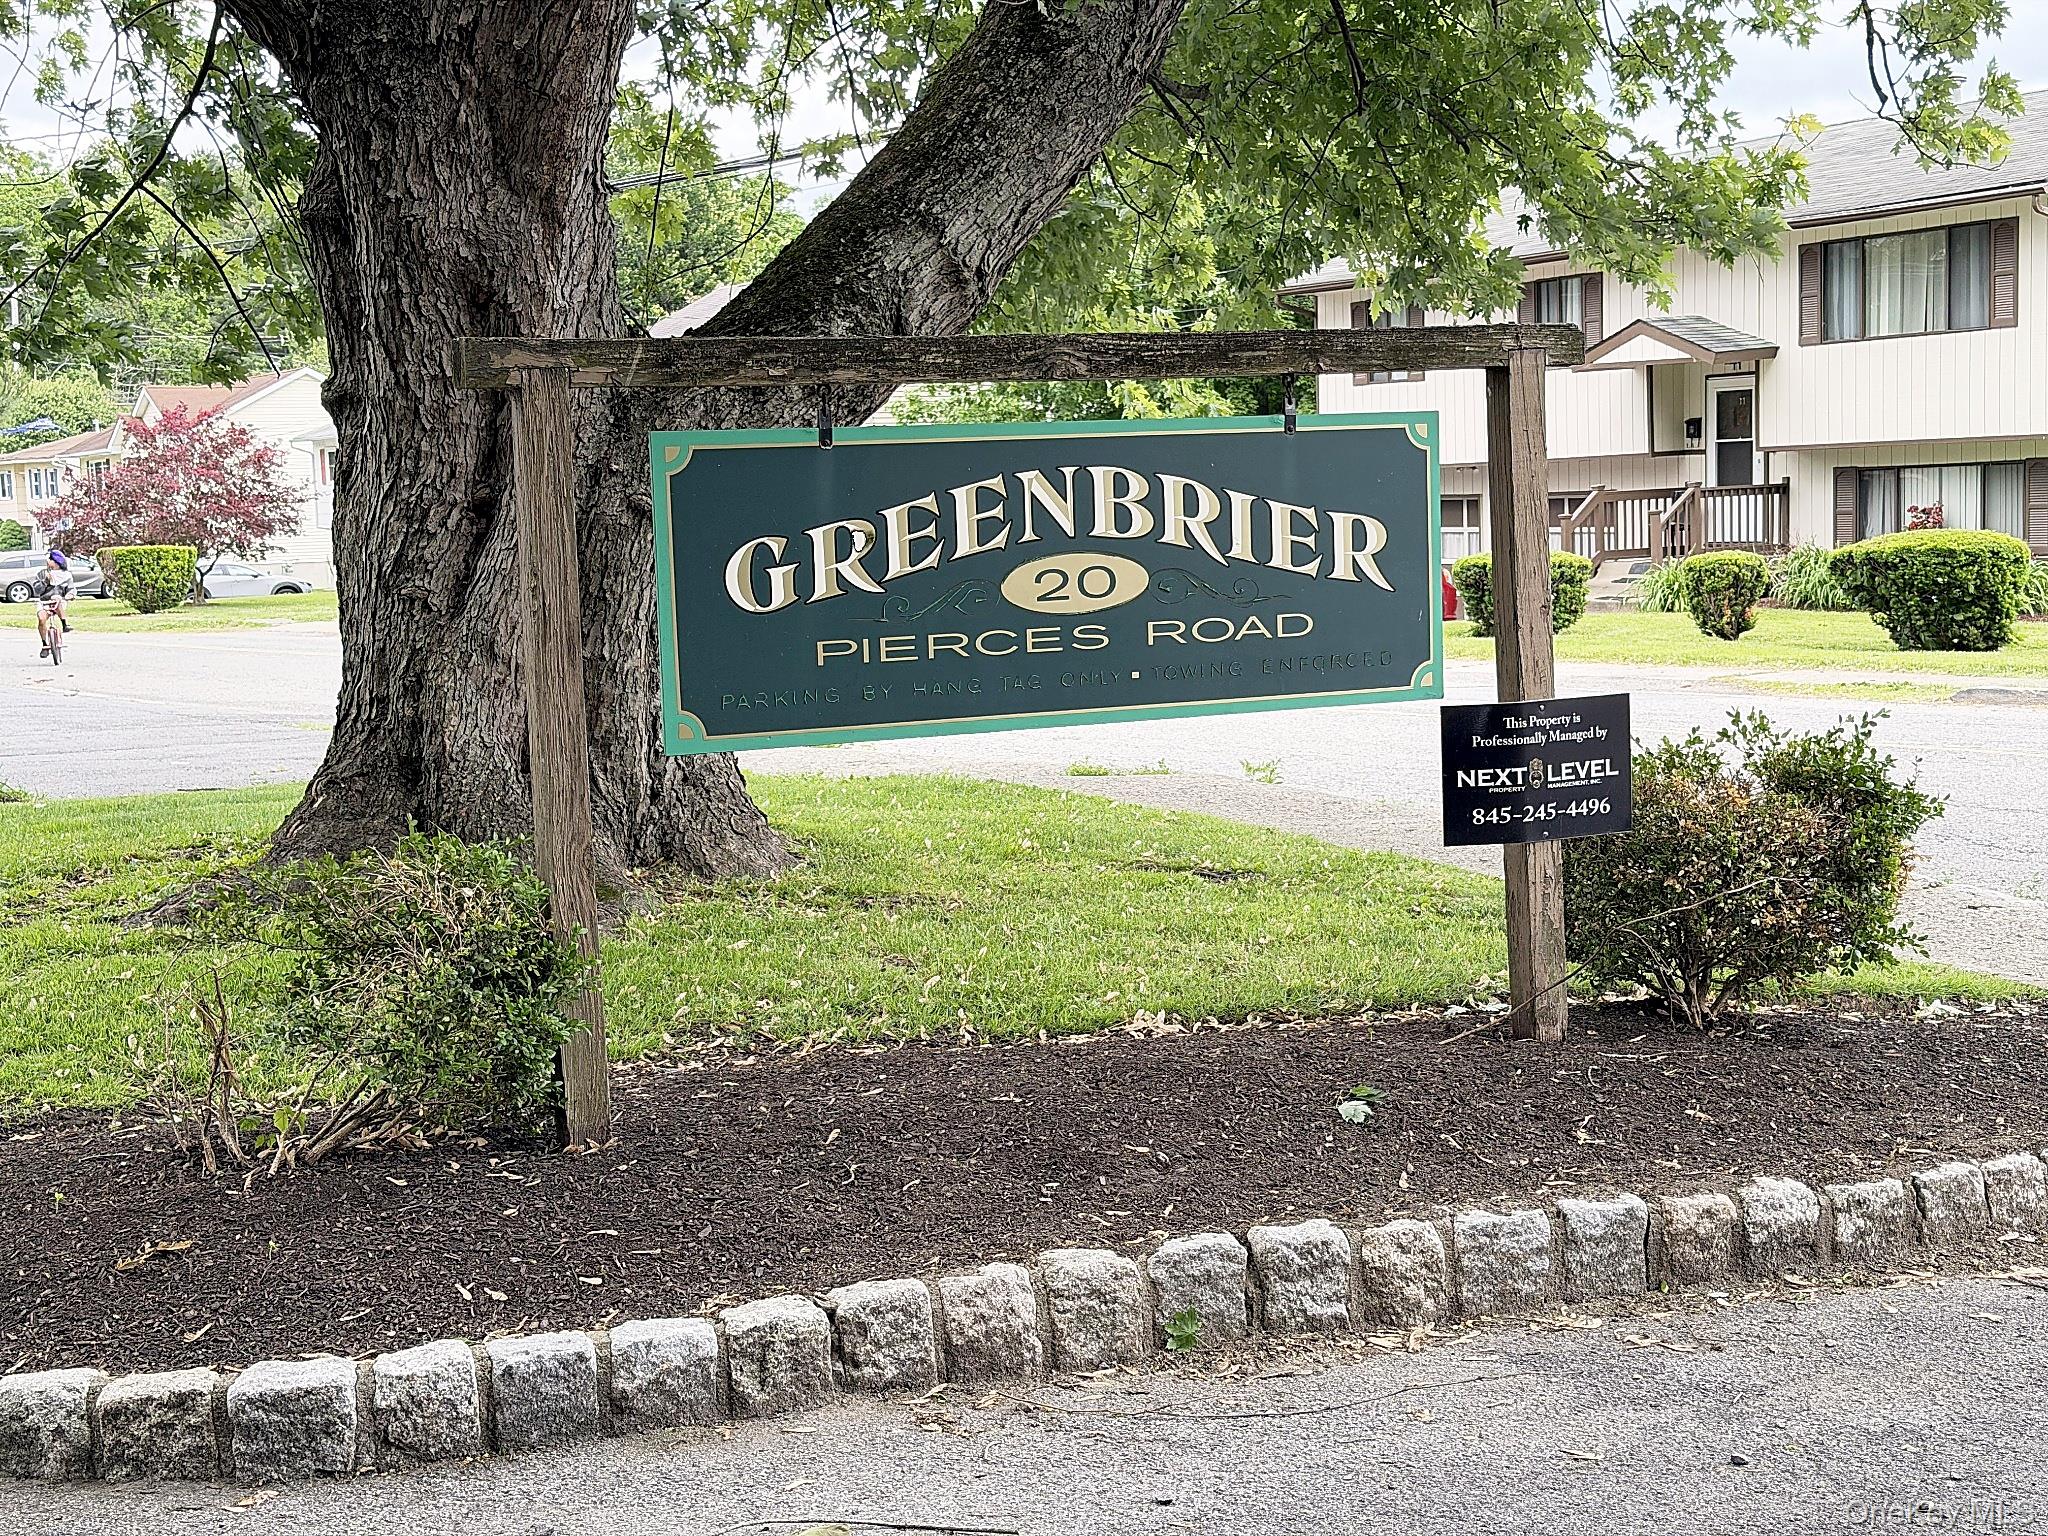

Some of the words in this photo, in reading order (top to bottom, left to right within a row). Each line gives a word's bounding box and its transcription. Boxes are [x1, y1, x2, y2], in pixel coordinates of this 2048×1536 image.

[725, 464, 1394, 614] GREENBRIER
[1033, 567, 1117, 602] 20
[816, 624, 1110, 667] PIERCES
[1147, 613, 1314, 646] ROAD
[721, 687, 841, 711] PARKING
[862, 681, 894, 701] BY
[912, 678, 982, 696] HANG
[1000, 674, 1042, 692] TAG
[1060, 671, 1121, 688] ONLY
[1152, 661, 1243, 682] TOWING
[1261, 650, 1393, 675] ENFORCED
[1472, 731, 1547, 747] Professionally
[1549, 728, 1594, 743] Managed
[1596, 727, 1608, 740] by
[1503, 717, 1527, 729] This
[1529, 714, 1571, 729] Property
[1573, 713, 1581, 723] is
[1456, 766, 1528, 788] NEXT
[1547, 758, 1620, 782] LEVEL
[1472, 797, 1611, 825] 845-245-4496
